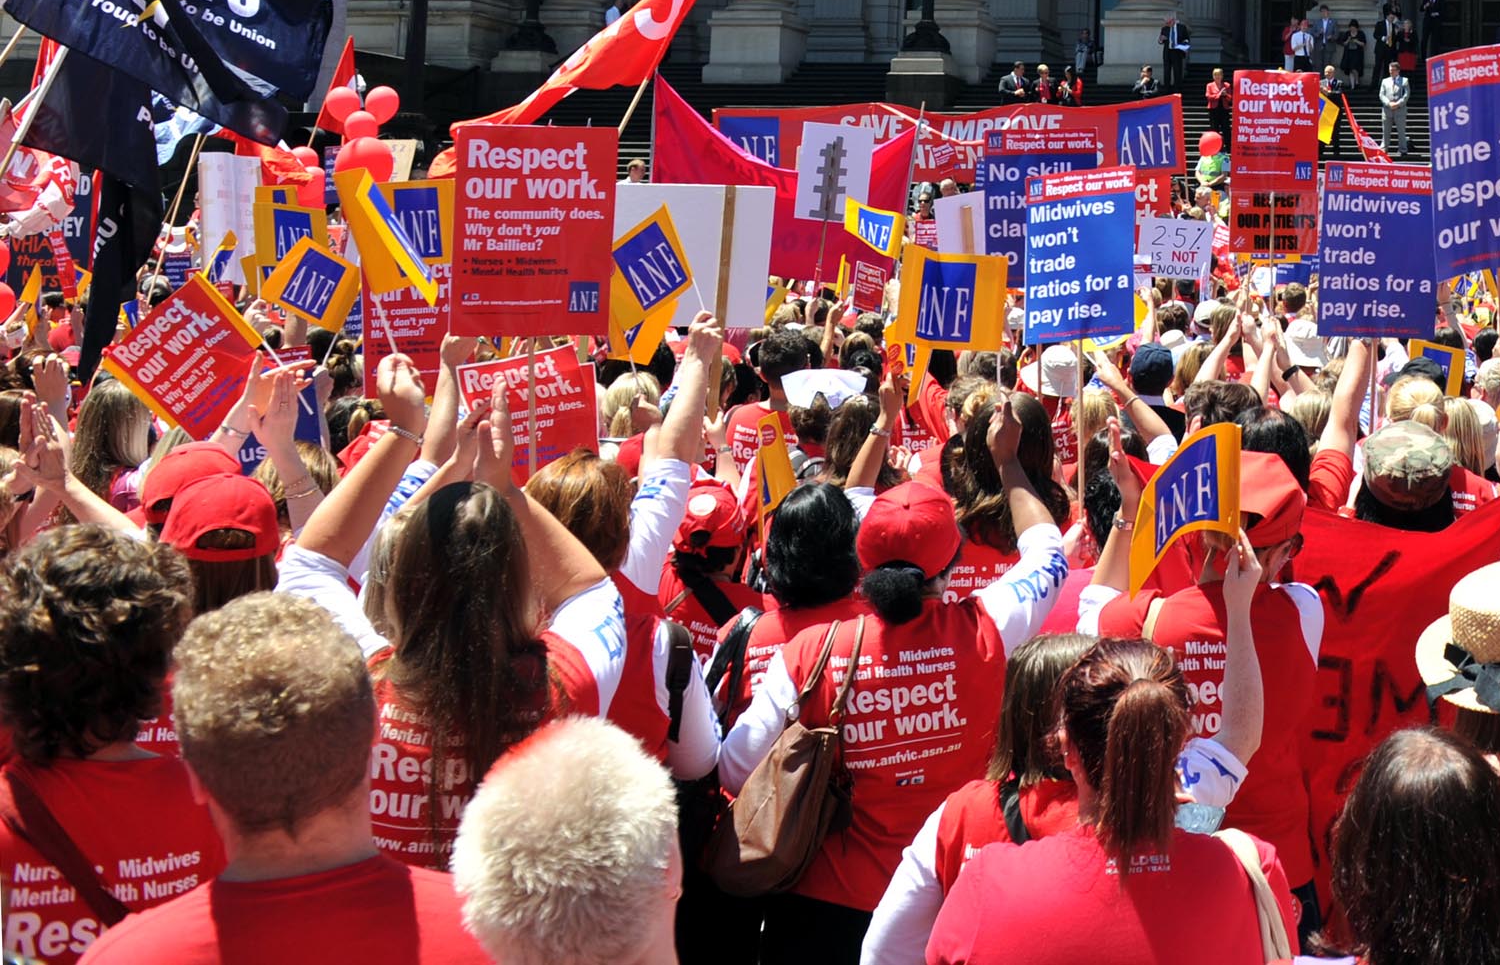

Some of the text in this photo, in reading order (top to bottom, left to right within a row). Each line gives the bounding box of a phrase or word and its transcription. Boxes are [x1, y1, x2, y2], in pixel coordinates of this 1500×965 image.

[180, 0, 277, 51] to be Union
[142, 25, 158, 41] to
[158, 36, 178, 58] be
[1449, 62, 1499, 83] Respect
[1240, 78, 1303, 99] Respect
[1239, 97, 1314, 114] our work.
[1254, 117, 1293, 125] community
[1433, 102, 1470, 132] It's
[1239, 126, 1253, 134] Why
[1006, 138, 1095, 151] Respect our work.
[1120, 123, 1171, 167] ANF
[467, 139, 587, 174] Respect
[1435, 141, 1491, 171] time
[989, 163, 1019, 182] No
[1347, 175, 1409, 188] Respect our
[465, 172, 606, 199] our work.
[1046, 176, 1133, 196] Respect our work.
[989, 191, 1027, 209] mix
[1328, 194, 1421, 215] Midwives
[465, 207, 604, 221] The community does.
[1030, 200, 1115, 224] Midwives
[1238, 213, 1259, 228] OUR
[465, 223, 560, 237] Why don't you
[858, 217, 890, 249] ANF
[1031, 227, 1079, 249] won't
[1326, 222, 1381, 239] won't
[1438, 220, 1480, 249] our
[463, 238, 543, 251] Mr Baillieu?
[1324, 247, 1376, 264] trade
[1030, 253, 1076, 274] trade
[1152, 250, 1198, 263] IS NOT
[627, 242, 683, 307] ANF
[1151, 264, 1199, 276] ENOUGH
[283, 266, 336, 314] ANF
[1030, 274, 1128, 299] ratios for a
[1323, 273, 1431, 293] ratios for a
[568, 291, 598, 312] ANF
[917, 283, 970, 337] ANF
[1322, 300, 1405, 320] pay rise.
[417, 318, 436, 327] you
[1029, 302, 1107, 328] pay rise.
[112, 298, 192, 368] Respect
[137, 312, 220, 383] our work.
[153, 330, 231, 395] The community does.
[162, 356, 216, 405] Why don't you
[171, 402, 186, 415] Mr
[184, 371, 217, 403] Baillieu?
[558, 401, 585, 412] does.
[1156, 462, 1211, 553] ANF
[899, 646, 954, 663] Midwives
[875, 661, 956, 678] Health Nurses
[836, 673, 957, 717] Respect
[843, 703, 967, 744] our work.
[845, 743, 962, 770] www.anfvic.asn.au
[370, 789, 428, 819] our
[118, 850, 201, 879] Midwives
[10, 885, 76, 908] Mental
[143, 874, 199, 900] Nurses
